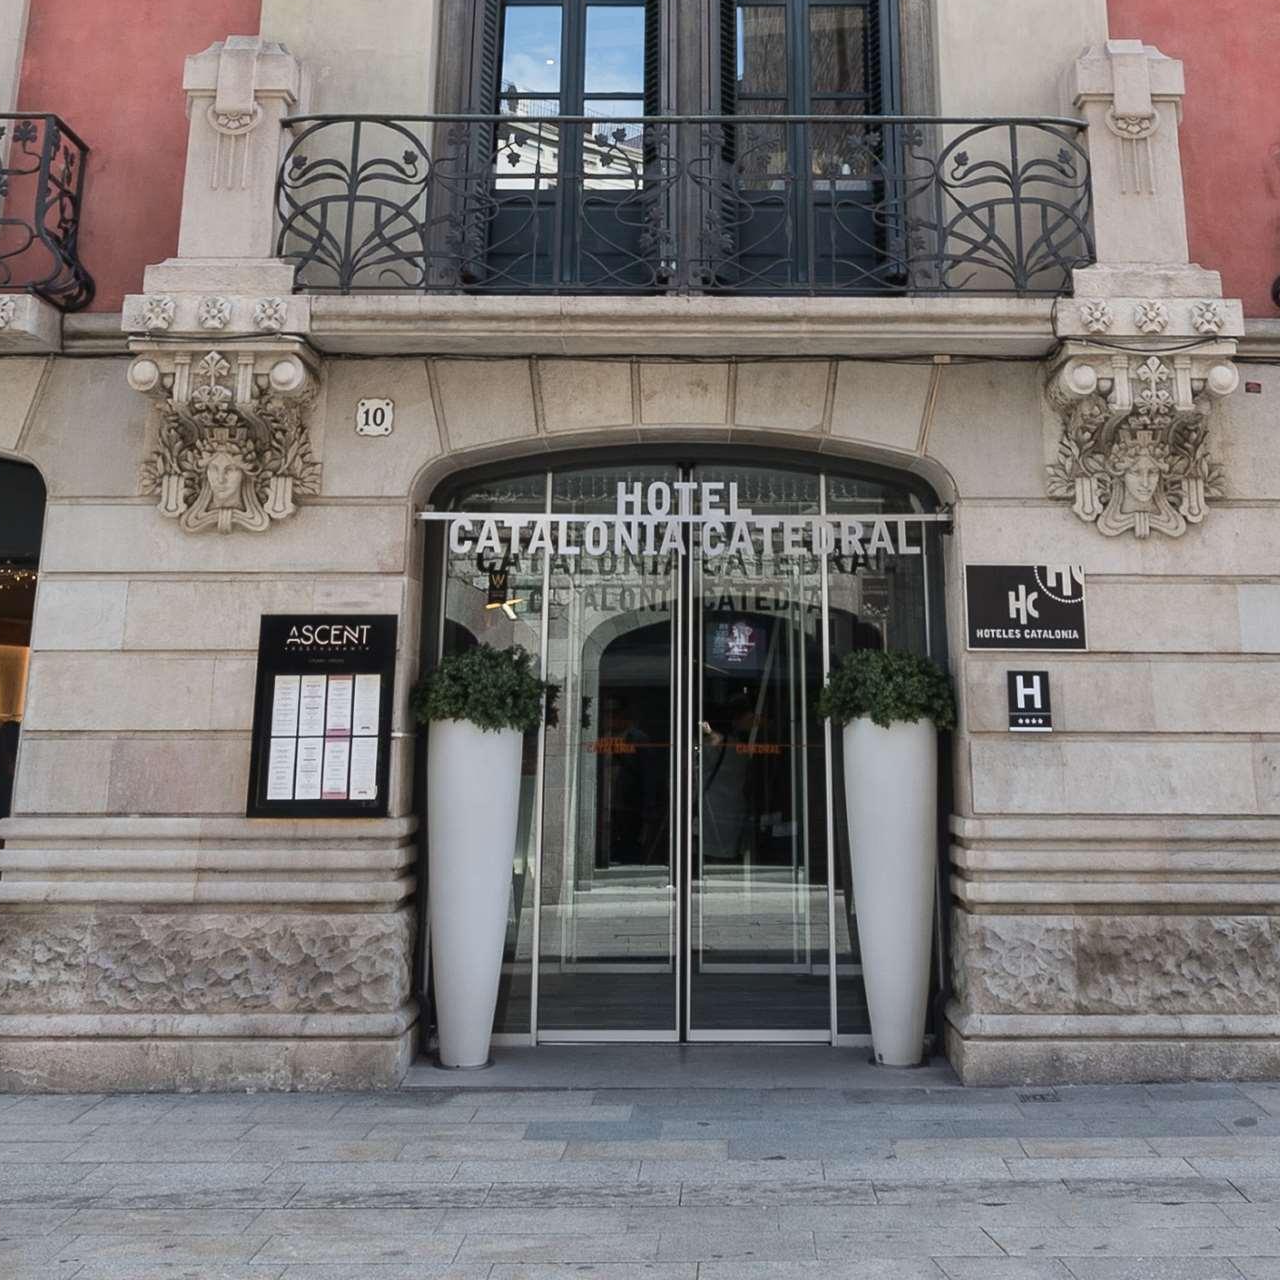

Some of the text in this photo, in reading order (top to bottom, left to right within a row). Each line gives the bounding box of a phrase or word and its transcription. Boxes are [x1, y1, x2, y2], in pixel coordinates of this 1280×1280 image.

[363, 407, 385, 427] 10
[617, 481, 752, 516] HOTEL
[449, 518, 921, 555] CATALONIA CATEDRAL
[286, 625, 372, 645] ASCENT
[976, 629, 1079, 639] HOTELES CATALONIA
[1016, 675, 1042, 709] H
